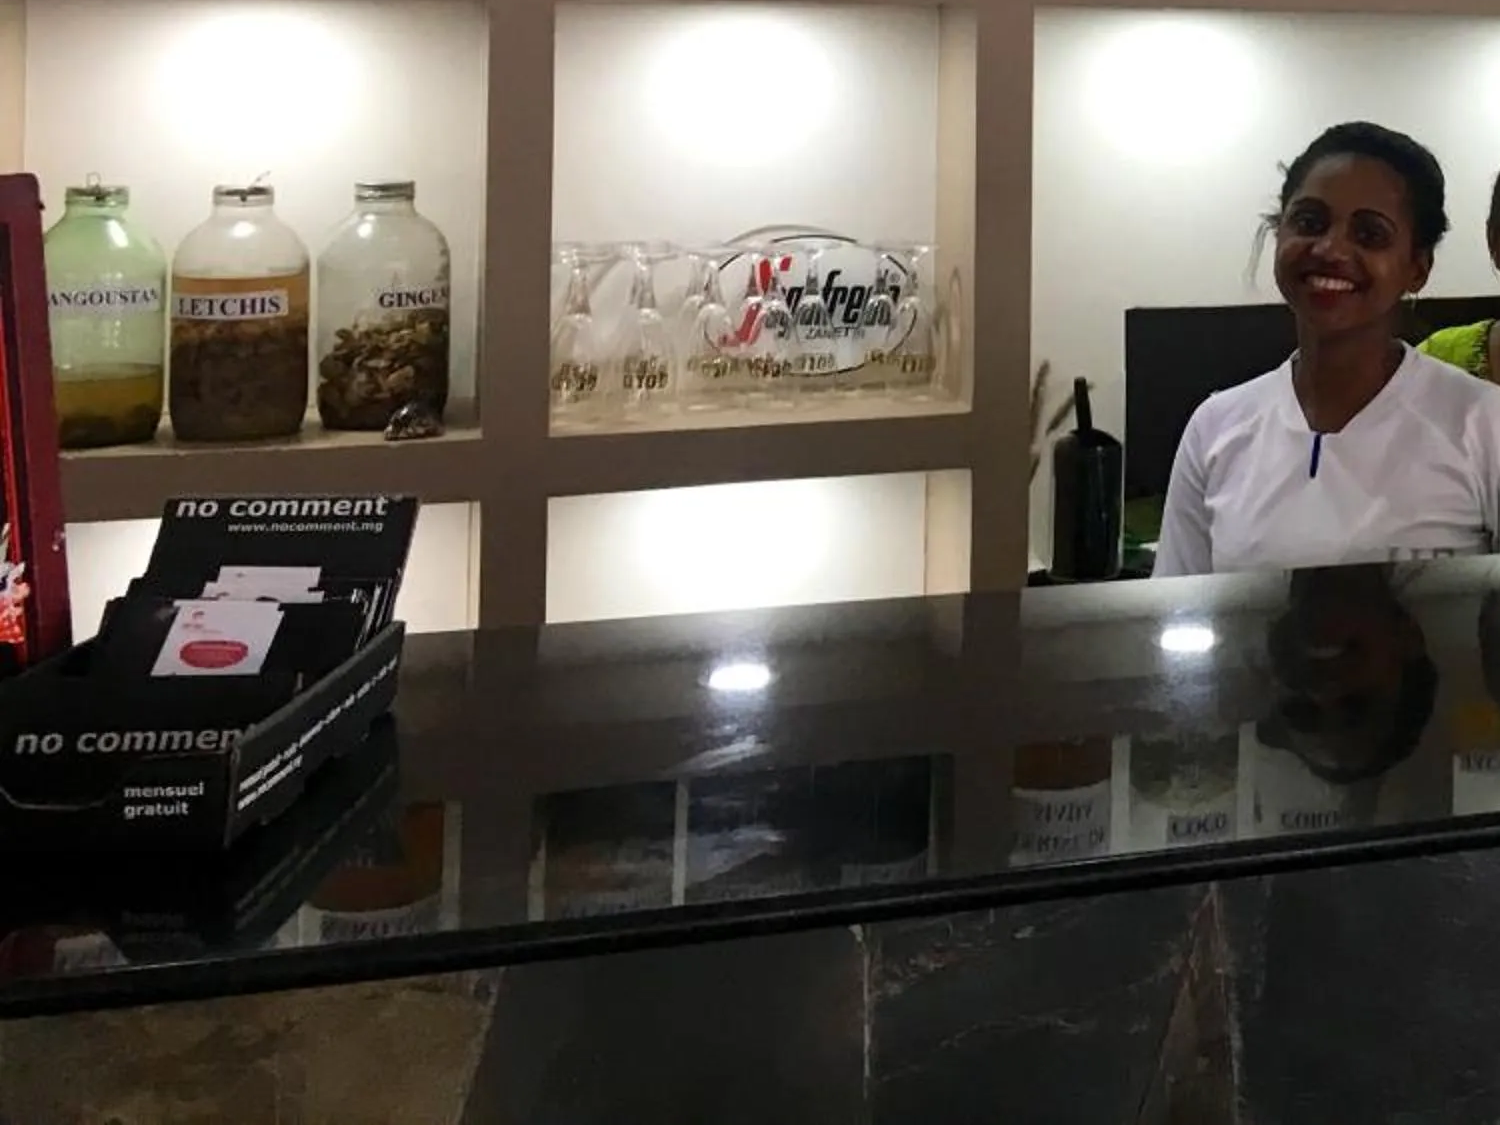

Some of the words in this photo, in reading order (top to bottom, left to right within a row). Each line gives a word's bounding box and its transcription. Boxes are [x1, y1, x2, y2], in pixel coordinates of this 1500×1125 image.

[178, 296, 282, 317] LETCHIS
[175, 500, 219, 517] no
[229, 496, 389, 517] comment
[227, 521, 384, 534] www.nocomment.mg
[15, 733, 64, 754] no
[76, 728, 239, 754] commen
[123, 782, 204, 798] mensuel
[123, 800, 189, 819] gratuit
